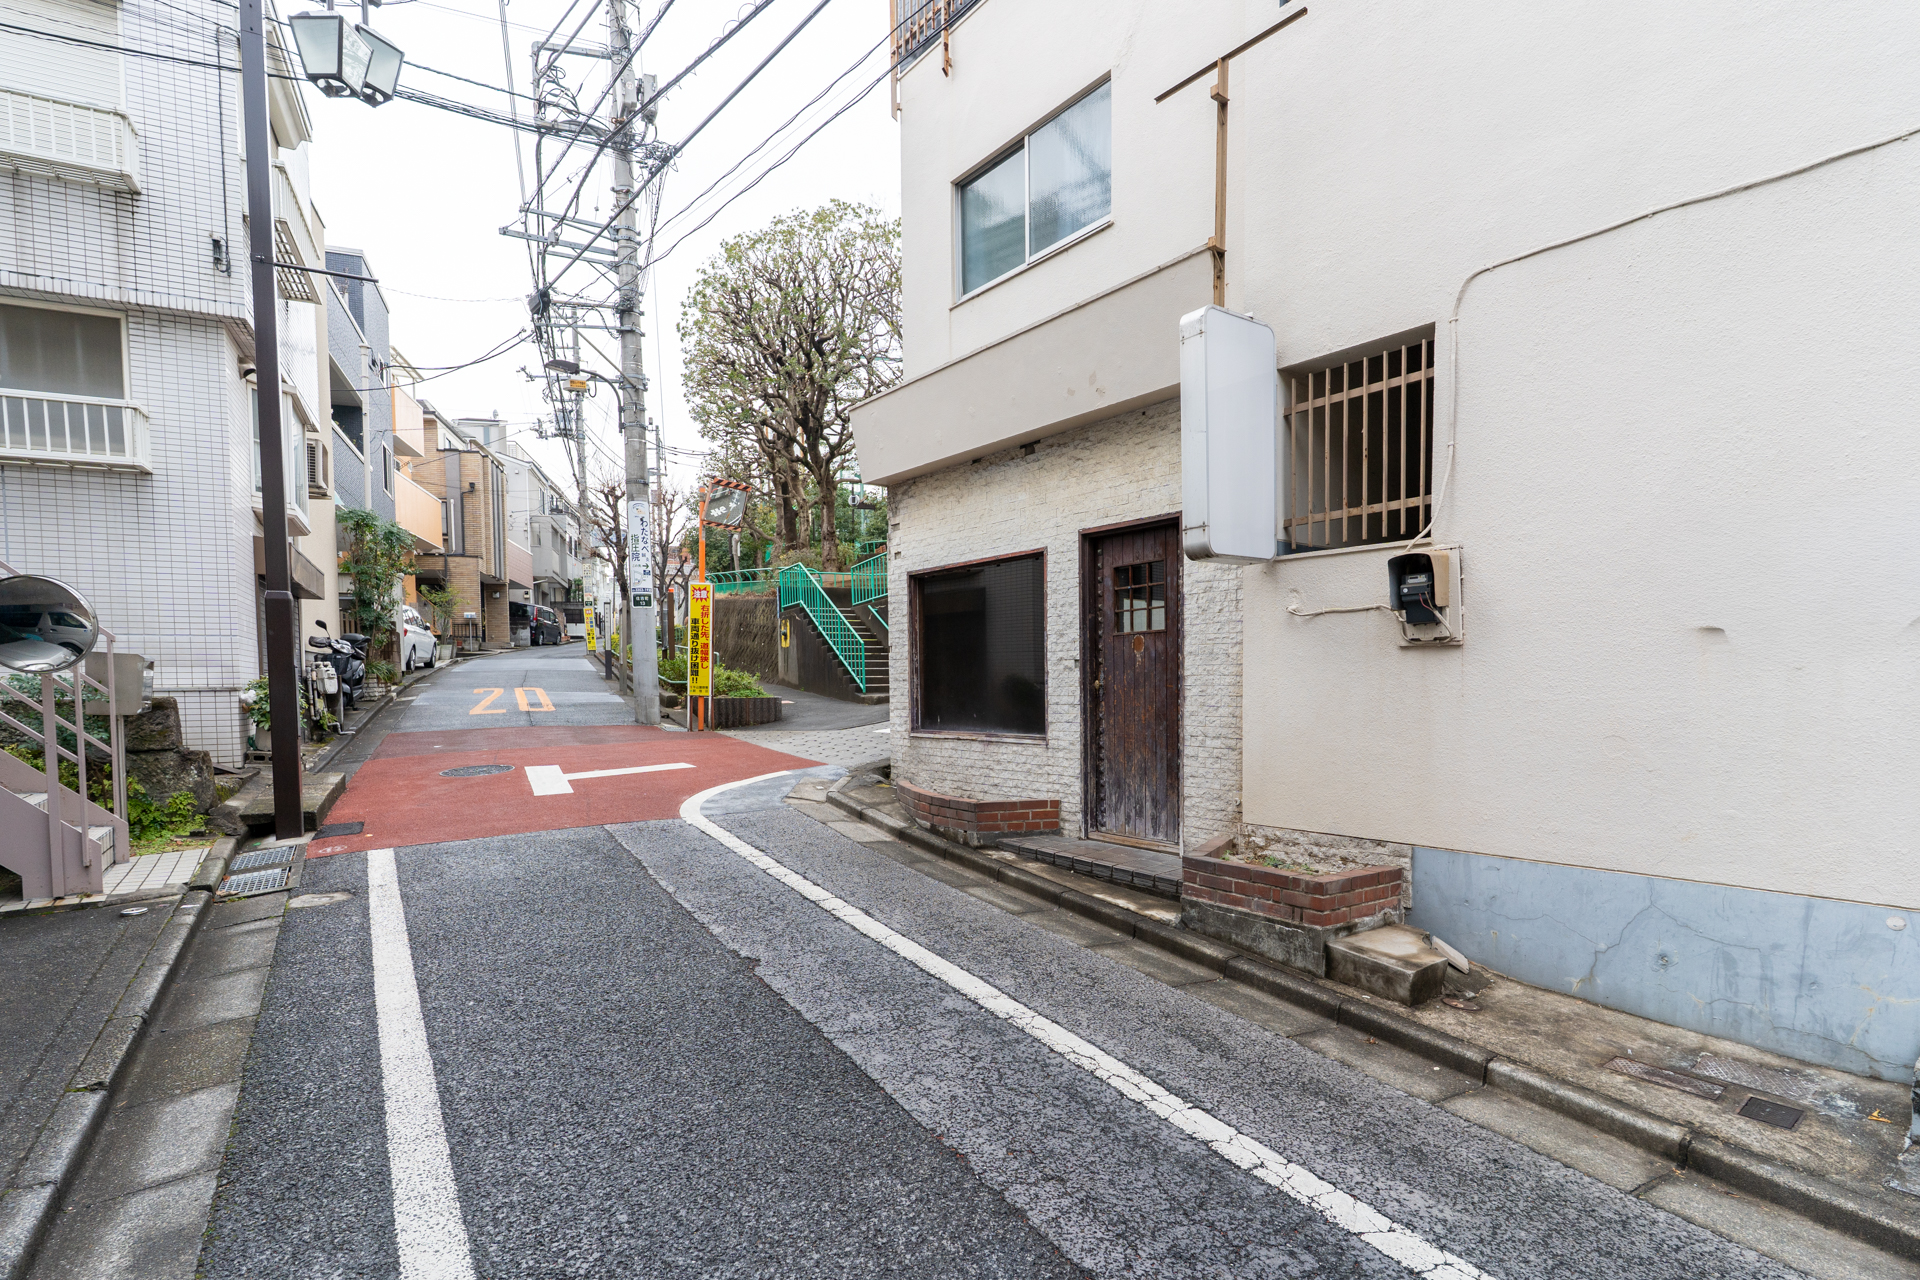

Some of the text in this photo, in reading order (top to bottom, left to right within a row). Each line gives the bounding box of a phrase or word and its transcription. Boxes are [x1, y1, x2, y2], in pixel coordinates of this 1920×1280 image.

[631, 534, 641, 562] 指圧院
[640, 519, 650, 552] わたなべ
[693, 590, 708, 599] 注意
[469, 687, 556, 715] 20
